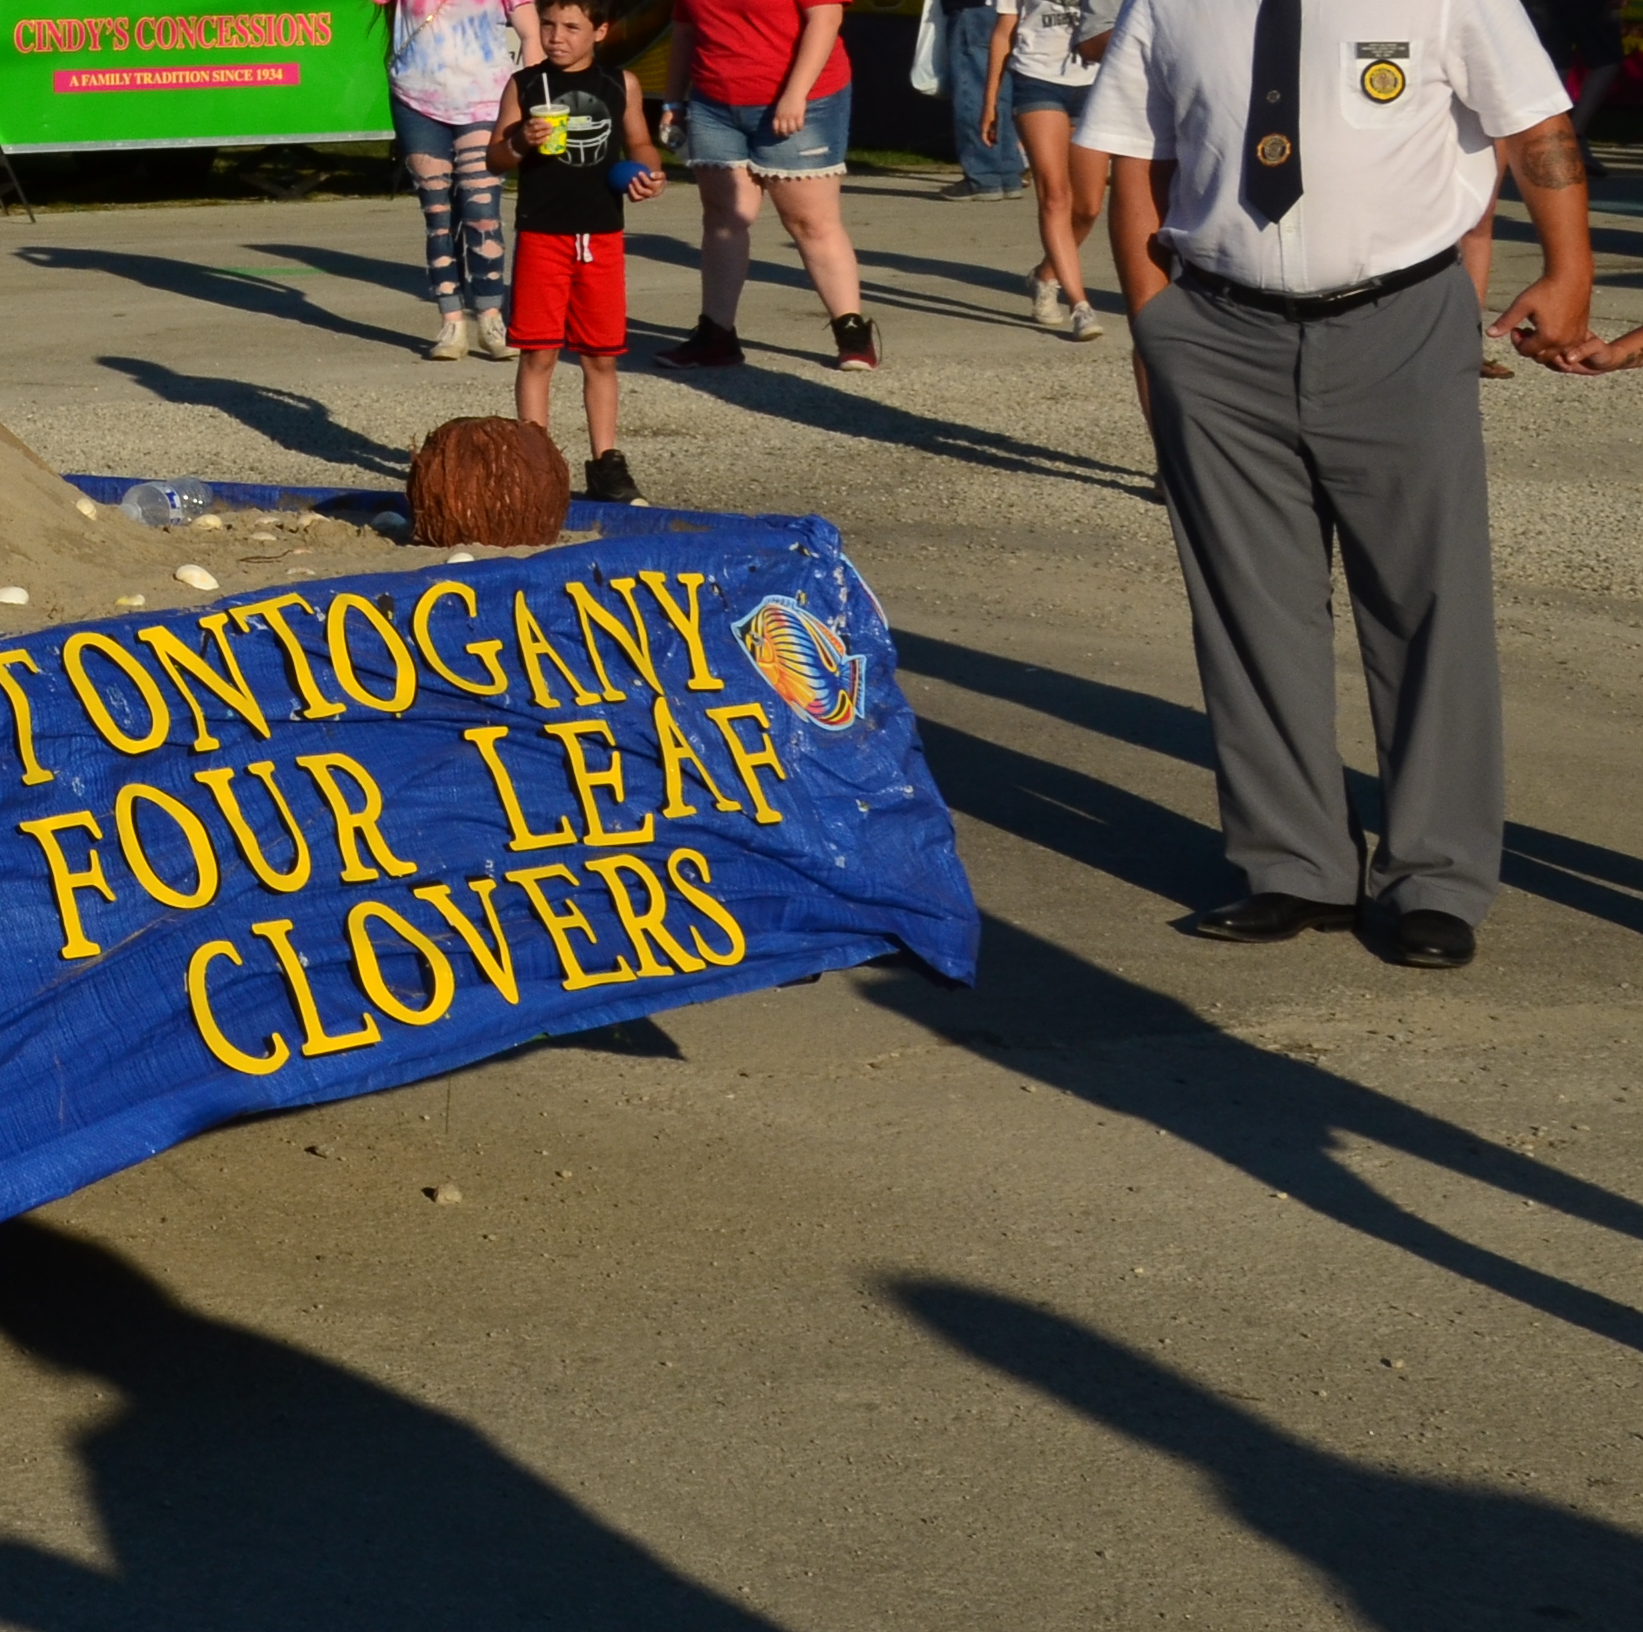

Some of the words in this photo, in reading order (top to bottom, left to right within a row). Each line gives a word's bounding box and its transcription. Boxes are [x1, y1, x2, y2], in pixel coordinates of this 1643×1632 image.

[13, 17, 130, 54] CINDY'S
[135, 12, 332, 51] CONCESSIONS
[69, 75, 79, 87] A
[81, 73, 132, 86] FAMILY
[134, 70, 210, 85] TRADITION
[212, 69, 253, 82] SINCE
[256, 68, 283, 81] 1934
[19, 752, 419, 961] FOUR
[464, 696, 790, 853] LEAF
[186, 847, 747, 1077] CLOVERS
